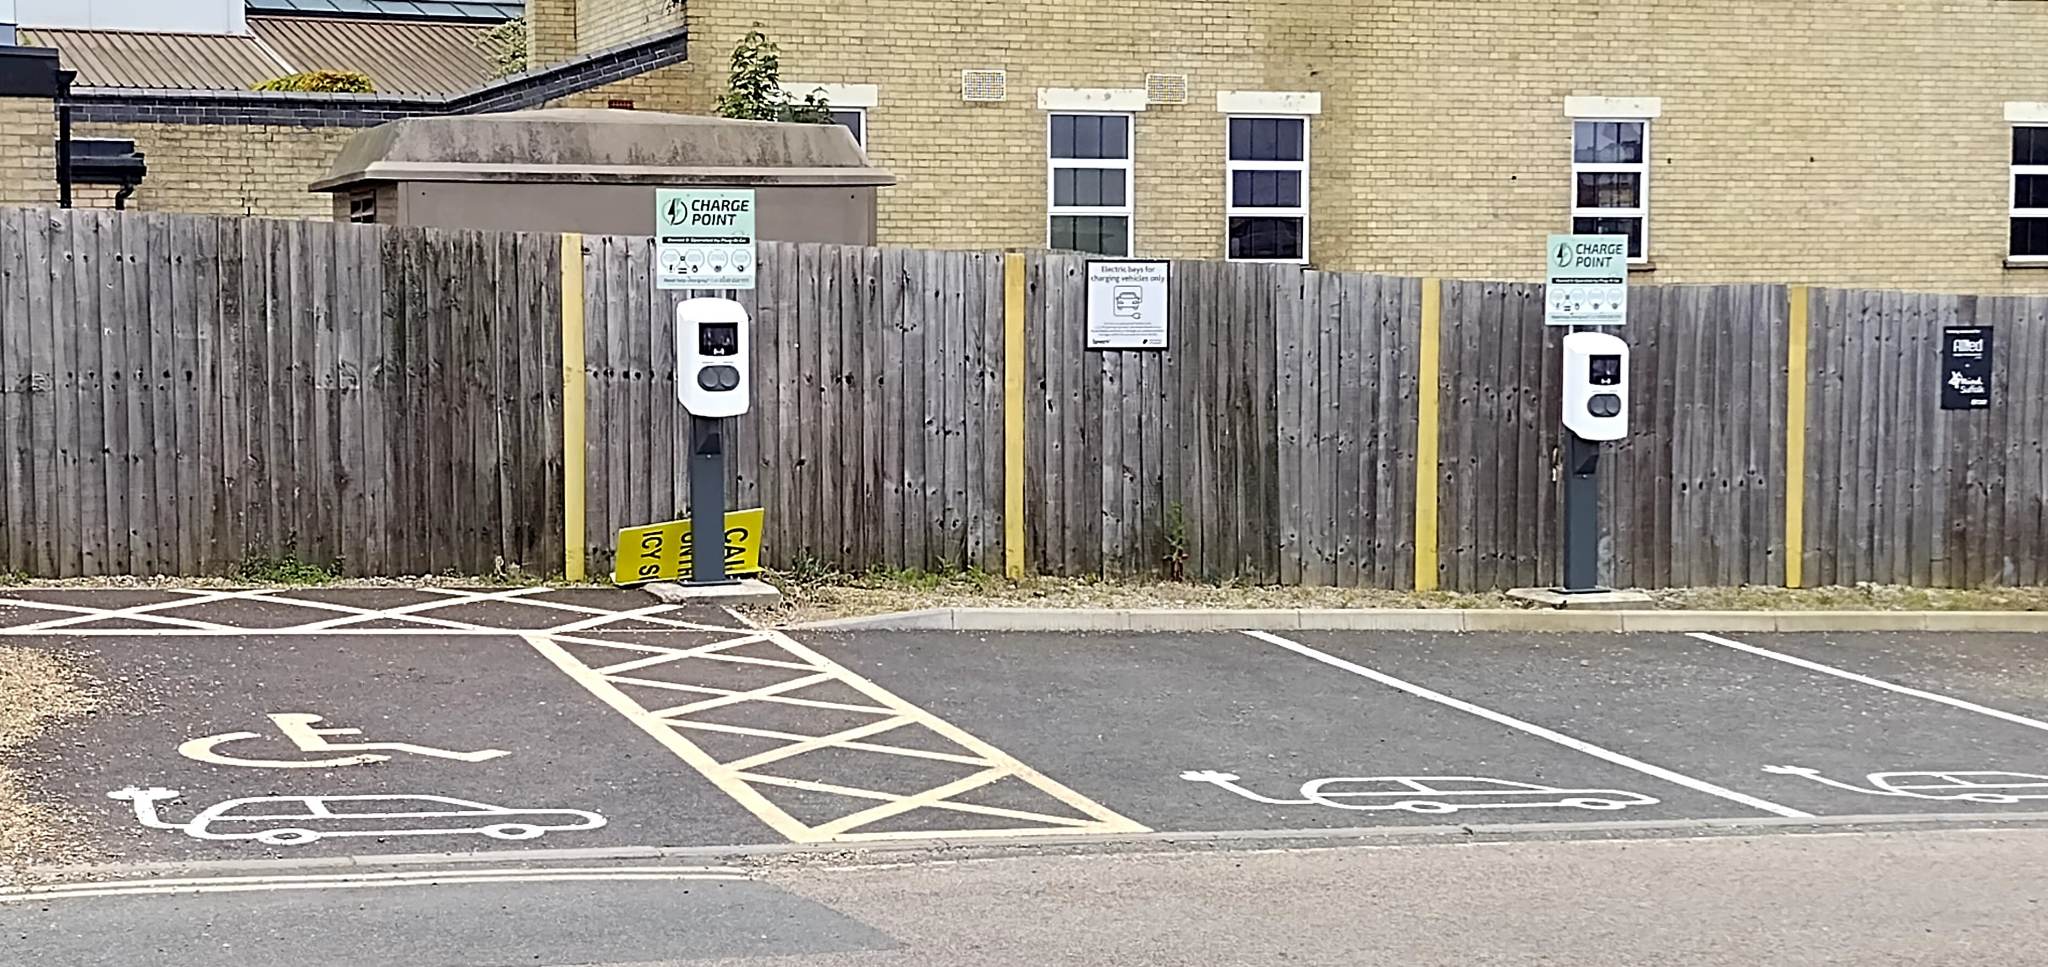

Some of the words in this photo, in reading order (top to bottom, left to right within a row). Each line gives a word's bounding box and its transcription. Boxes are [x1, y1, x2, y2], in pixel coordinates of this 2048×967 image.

[691, 199, 750, 212] CHARGE
[691, 214, 737, 226] POINT
[1575, 243, 1624, 255] CHARGE
[1575, 256, 1613, 268] POINT
[1101, 265, 1127, 273] Electric
[1145, 265, 1155, 273] for
[1091, 275, 1120, 283] charging
[1150, 275, 1165, 283] only
[640, 530, 664, 560] ICY
